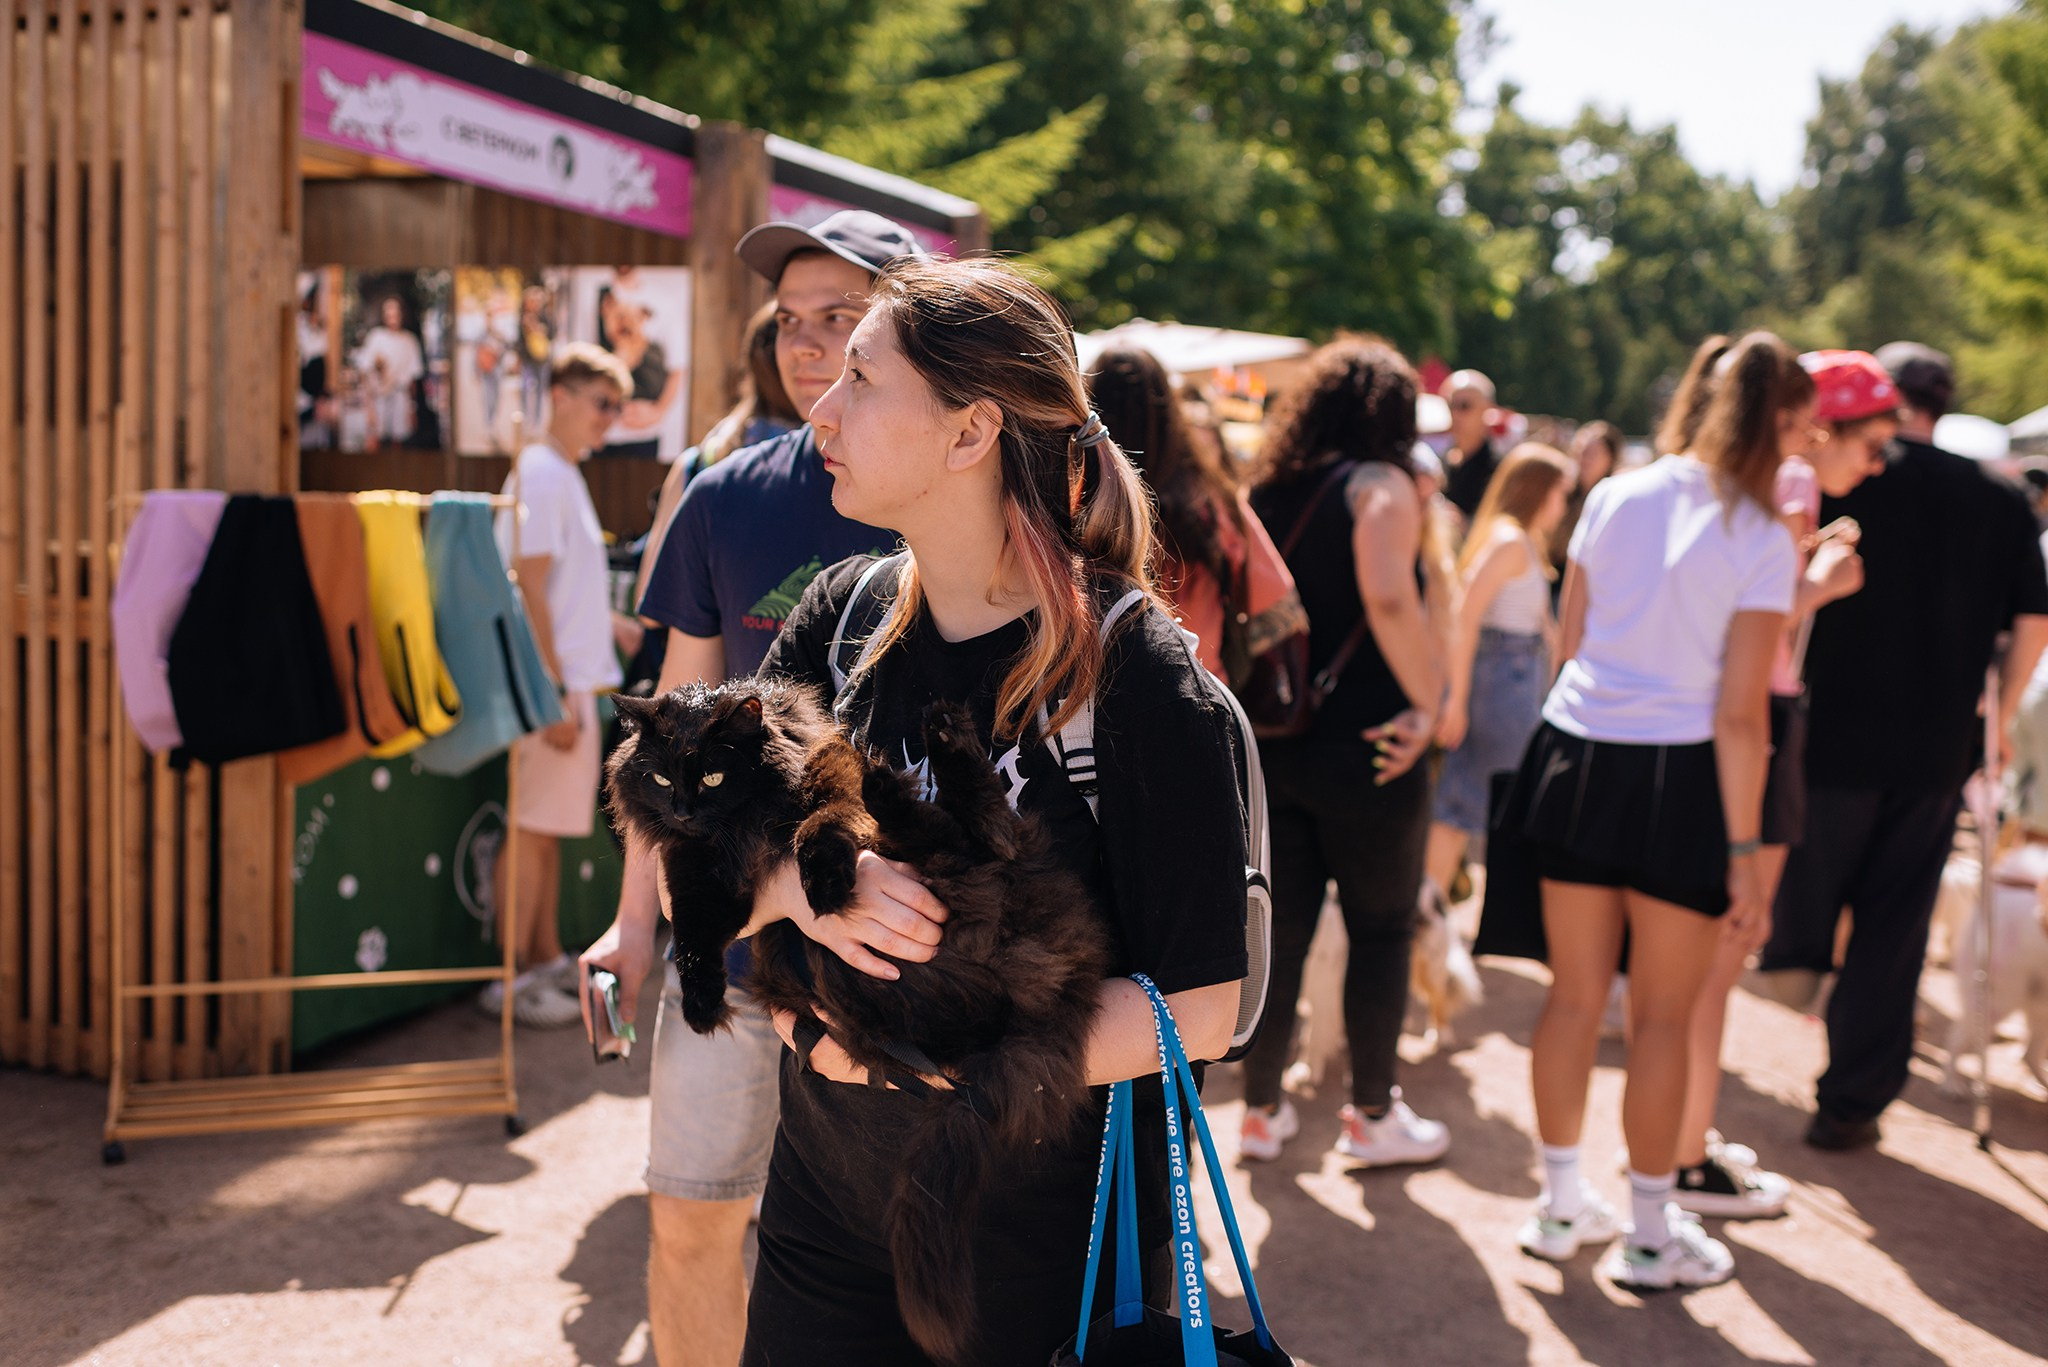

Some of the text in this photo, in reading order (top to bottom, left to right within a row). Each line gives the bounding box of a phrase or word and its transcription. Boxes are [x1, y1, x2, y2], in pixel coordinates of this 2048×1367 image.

[742, 616, 775, 630] YOUR
[1166, 1106, 1203, 1329] we are ozon creators
